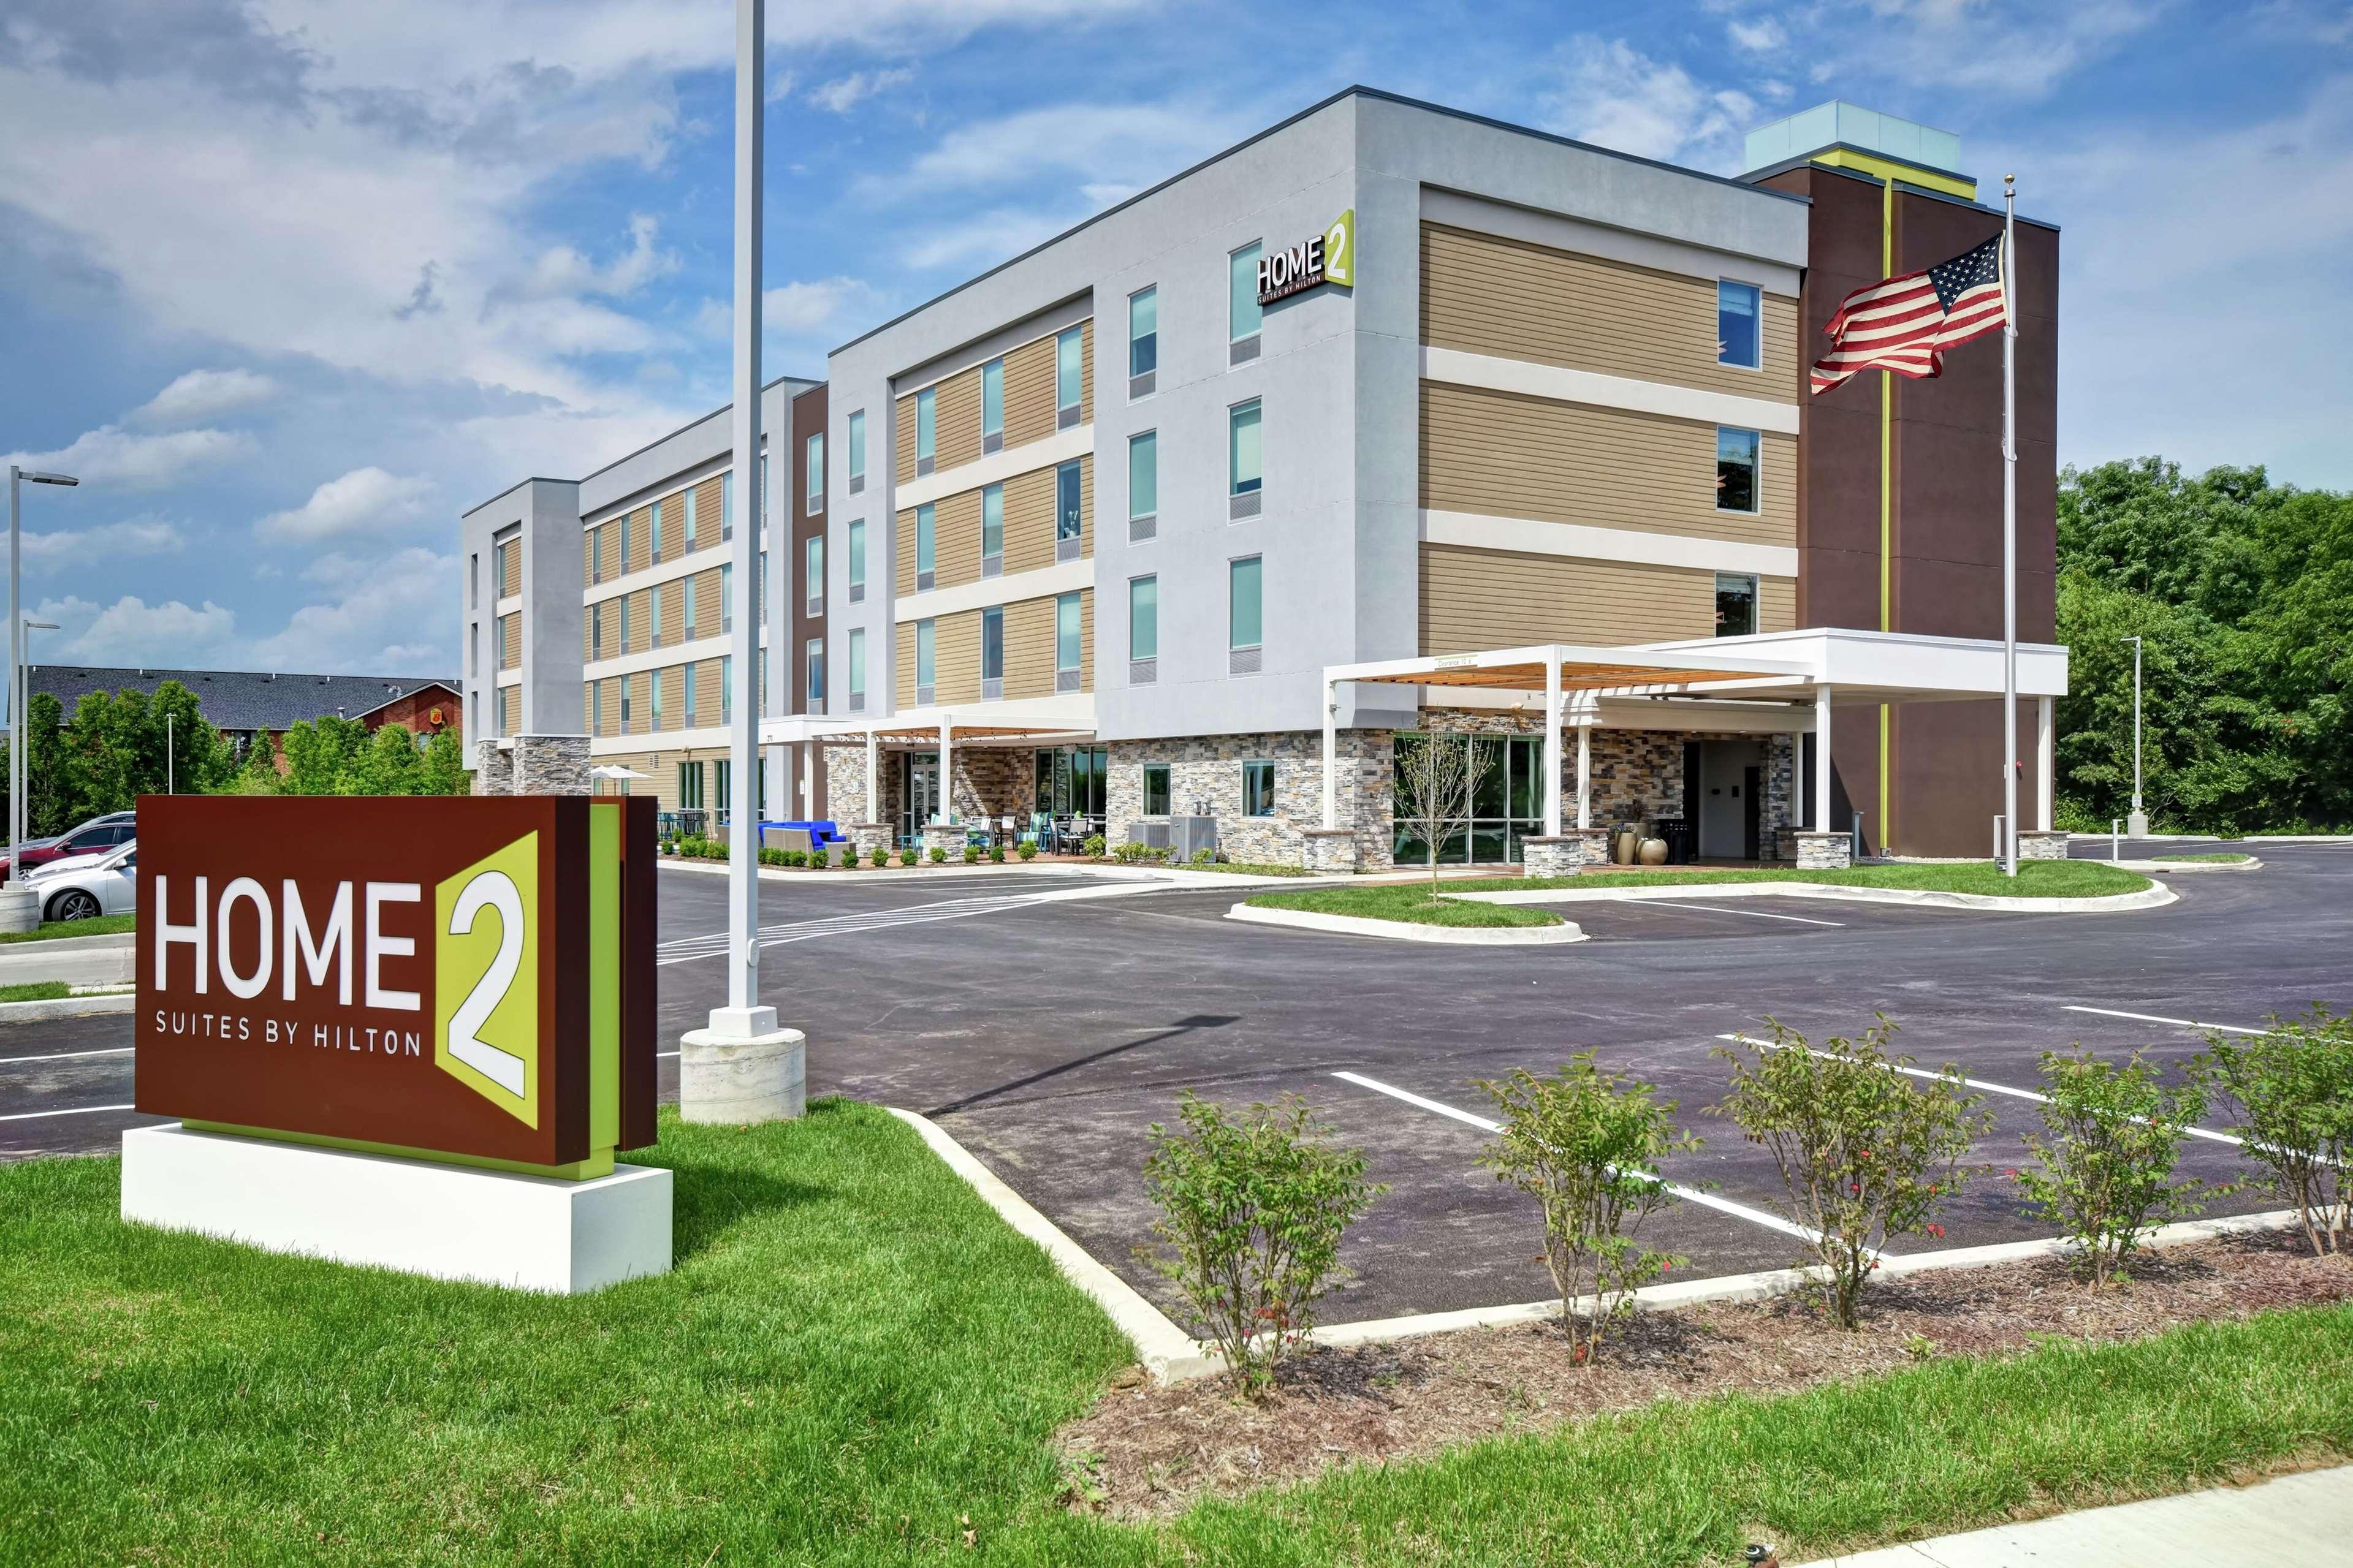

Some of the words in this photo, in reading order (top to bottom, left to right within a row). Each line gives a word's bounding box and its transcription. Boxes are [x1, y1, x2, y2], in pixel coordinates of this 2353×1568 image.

[1256, 235, 1322, 294] HOME
[1328, 223, 1346, 279] 2
[1258, 290, 1282, 304] SUITES
[1284, 286, 1293, 294] BY
[1296, 275, 1321, 290] HILTON
[154, 874, 422, 1012] HOME
[447, 870, 525, 1100] 2
[156, 1010, 250, 1041] SUITES
[265, 1019, 298, 1045] BY
[314, 1023, 420, 1057] HILTON
